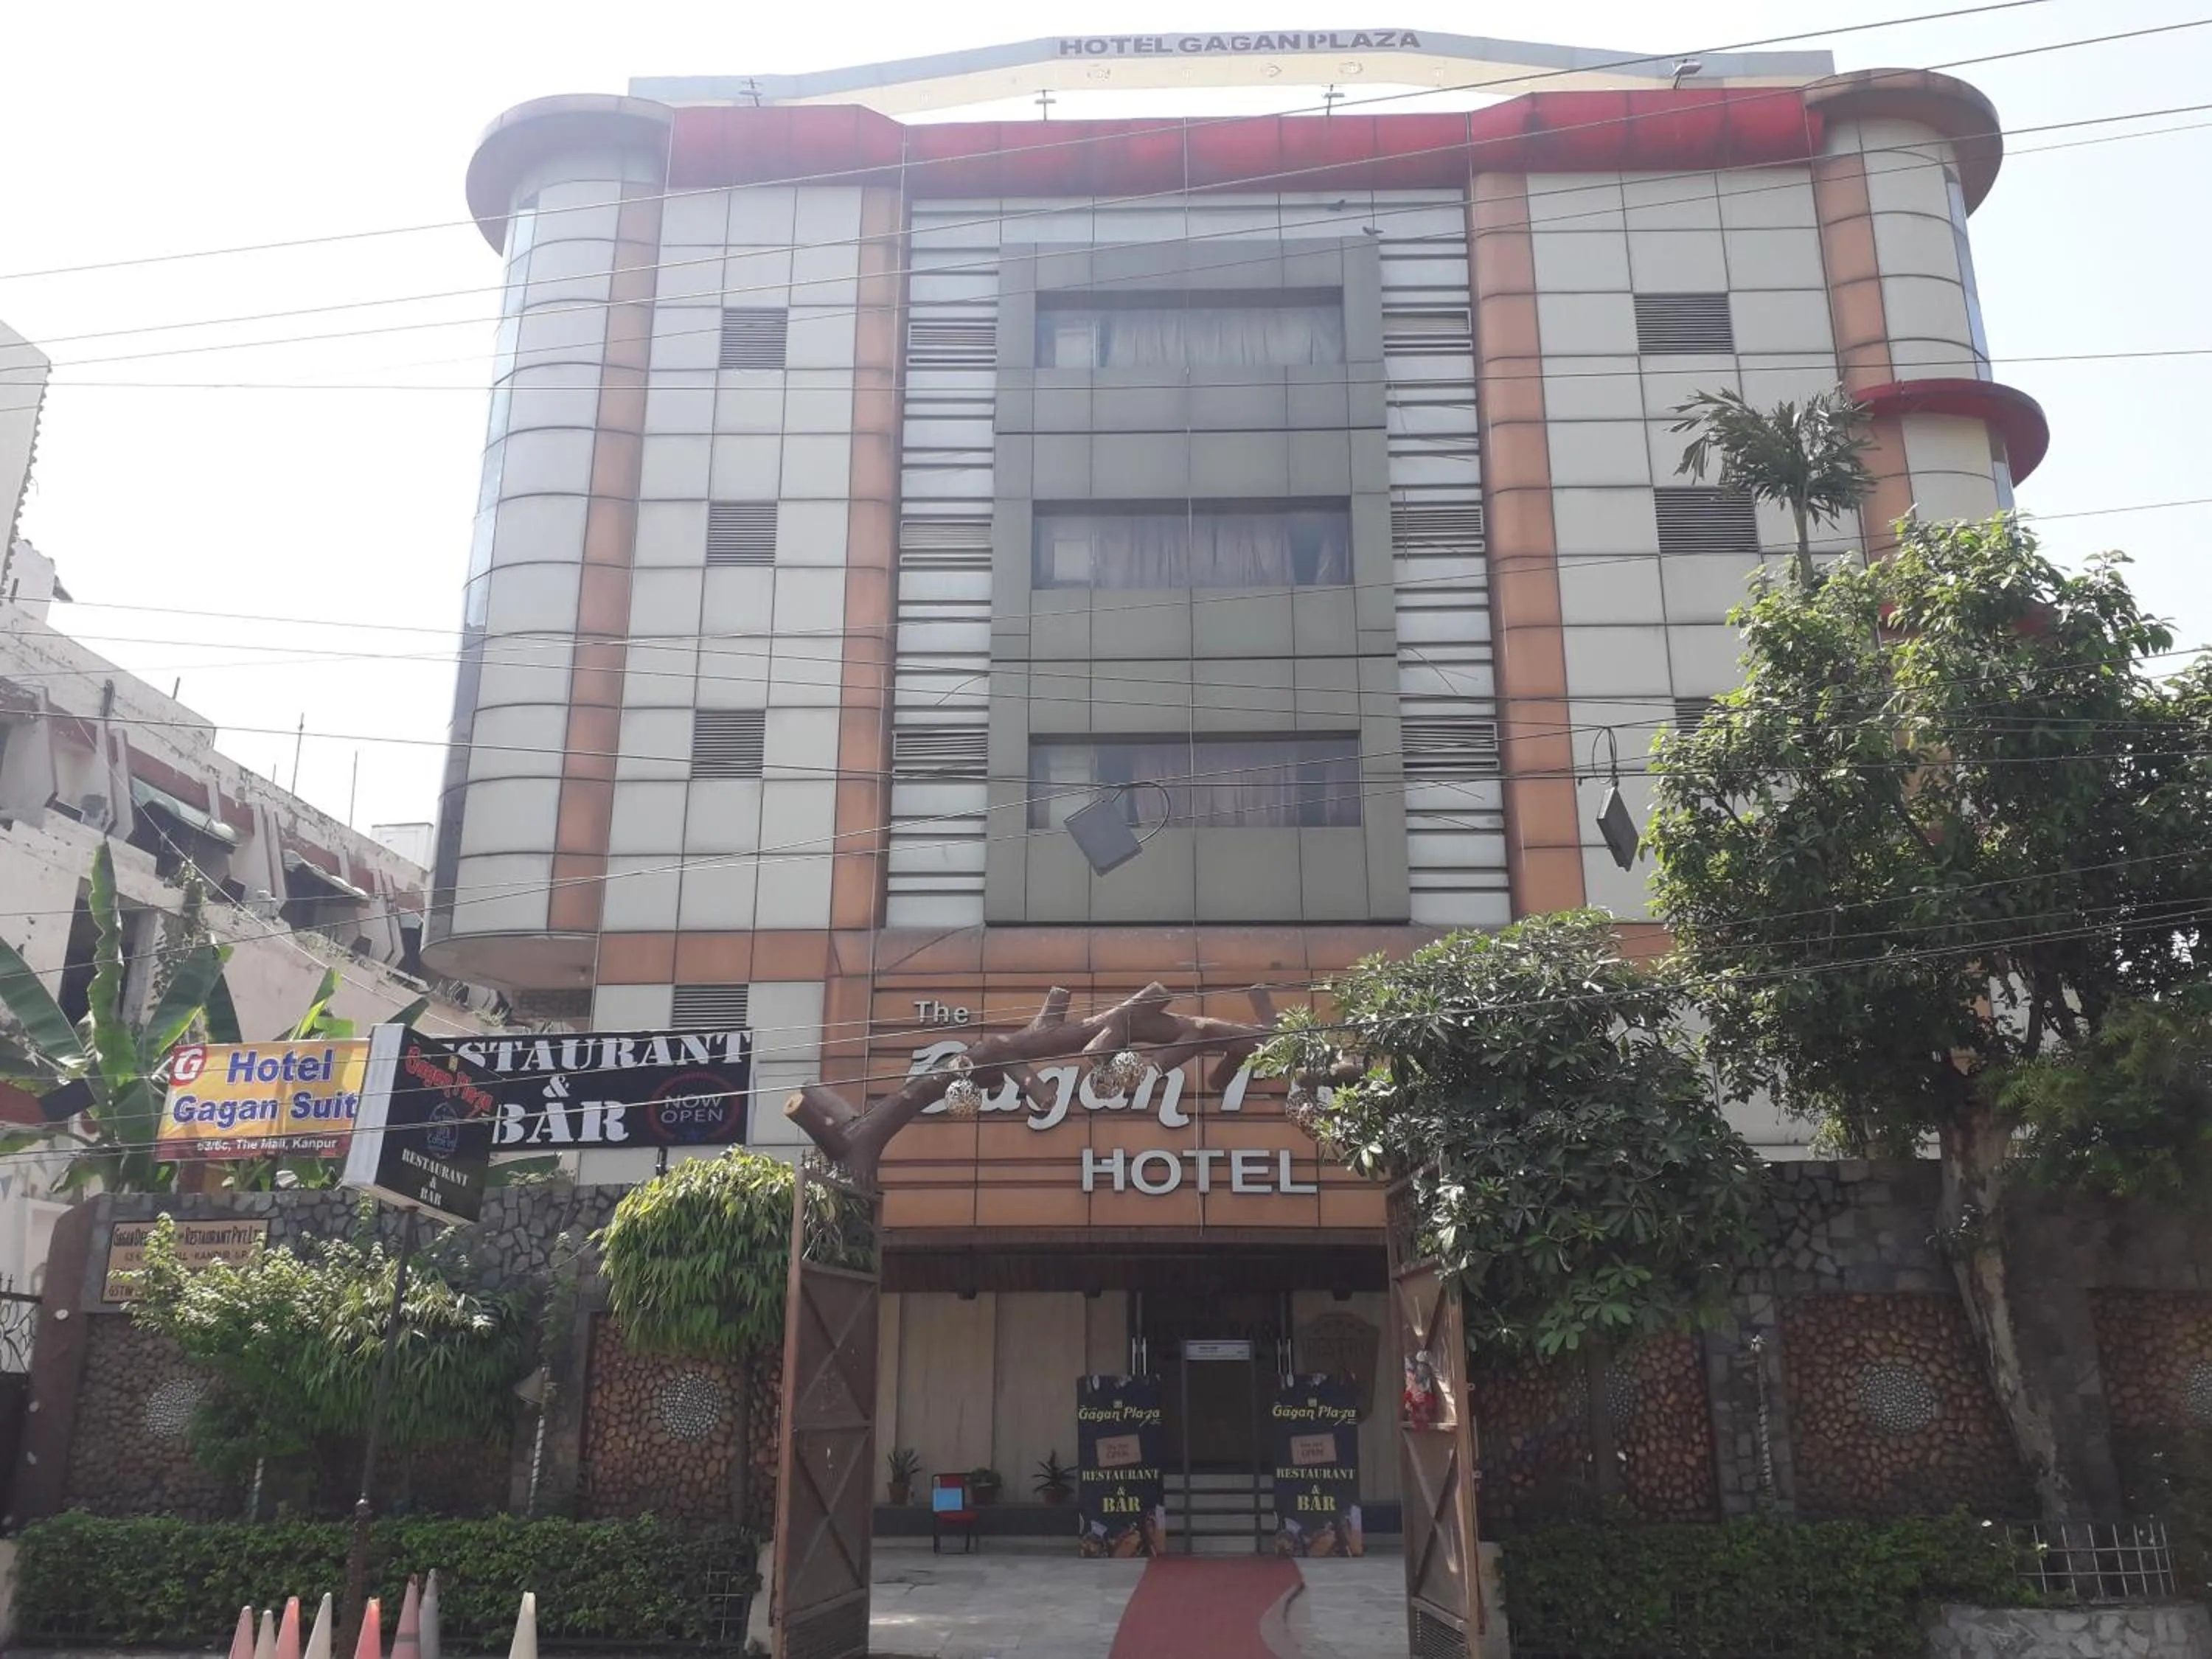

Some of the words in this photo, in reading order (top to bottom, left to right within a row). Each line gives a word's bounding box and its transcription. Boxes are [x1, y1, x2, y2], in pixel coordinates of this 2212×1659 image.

[1060, 35, 1172, 55] HOTEL
[1179, 33, 1301, 53] GAGAN
[1307, 31, 1422, 50] PLAZA
[913, 1000, 969, 1025] The
[442, 1032, 752, 1072] STAURANT
[226, 1048, 335, 1085] Hotel
[542, 1074, 571, 1098] &
[173, 1094, 279, 1130] Gagan
[664, 1092, 723, 1110] NOW
[491, 1100, 630, 1144] BAR
[660, 1107, 724, 1125] OPEN
[235, 1138, 258, 1151] The
[292, 1137, 338, 1151] Kanpur
[401, 1147, 468, 1187] RESTAURANT
[1081, 1148, 1318, 1195] HOTEL
[419, 1186, 442, 1207] BAR
[1078, 1404, 1121, 1422] Gagan
[1123, 1406, 1161, 1427] Plaza
[1272, 1402, 1315, 1422] Gagan
[1317, 1405, 1357, 1426] Plaza
[1082, 1467, 1160, 1481] RESTAURANT
[1276, 1467, 1356, 1480] RESTAURANT
[1116, 1486, 1126, 1497] &
[1311, 1484, 1321, 1495] &
[1102, 1496, 1141, 1512] BAR
[1296, 1495, 1336, 1512] BAR
